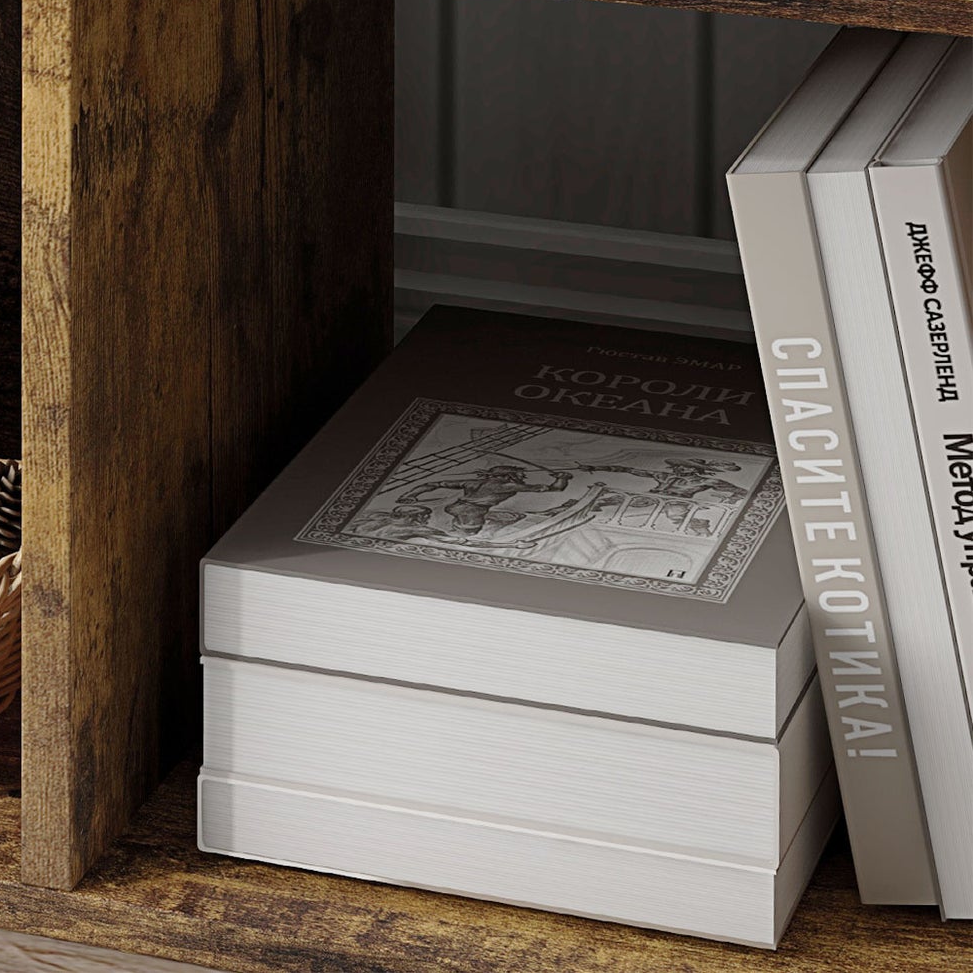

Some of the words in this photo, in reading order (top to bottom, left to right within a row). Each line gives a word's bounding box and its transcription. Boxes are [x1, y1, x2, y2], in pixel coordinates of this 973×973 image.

[531, 364, 755, 407] КОРОЛИ
[905, 222, 939, 294] ДЖЕФФ
[923, 298, 960, 402] САЗЕРЛЕНД
[514, 385, 731, 426] ОКЕАНА
[771, 337, 857, 542] СПАСИТЕ
[811, 558, 898, 758] КОТИКА!
